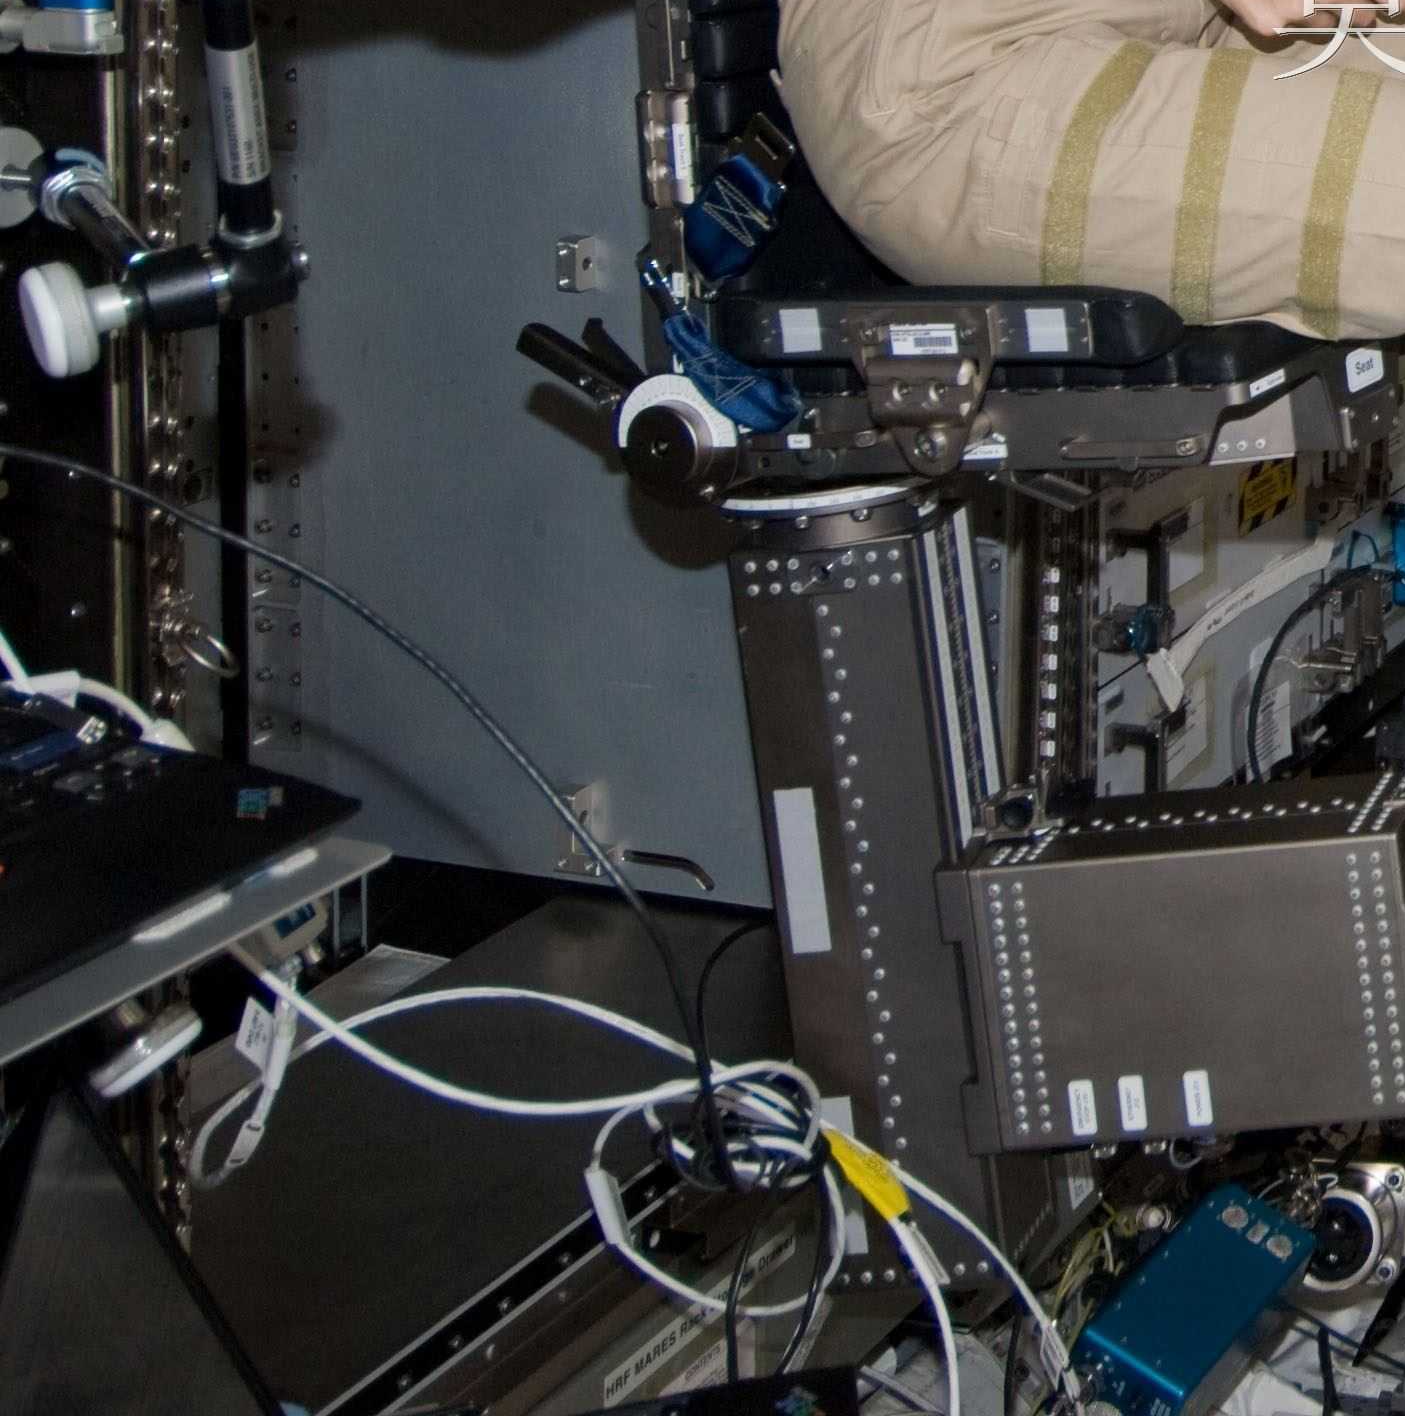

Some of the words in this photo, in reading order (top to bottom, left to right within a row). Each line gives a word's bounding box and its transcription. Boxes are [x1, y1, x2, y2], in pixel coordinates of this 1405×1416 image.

[1354, 357, 1375, 376] Seat
[605, 1369, 631, 1400] HRF
[634, 1335, 677, 1376] MARES
[758, 1236, 794, 1271] Drawer
